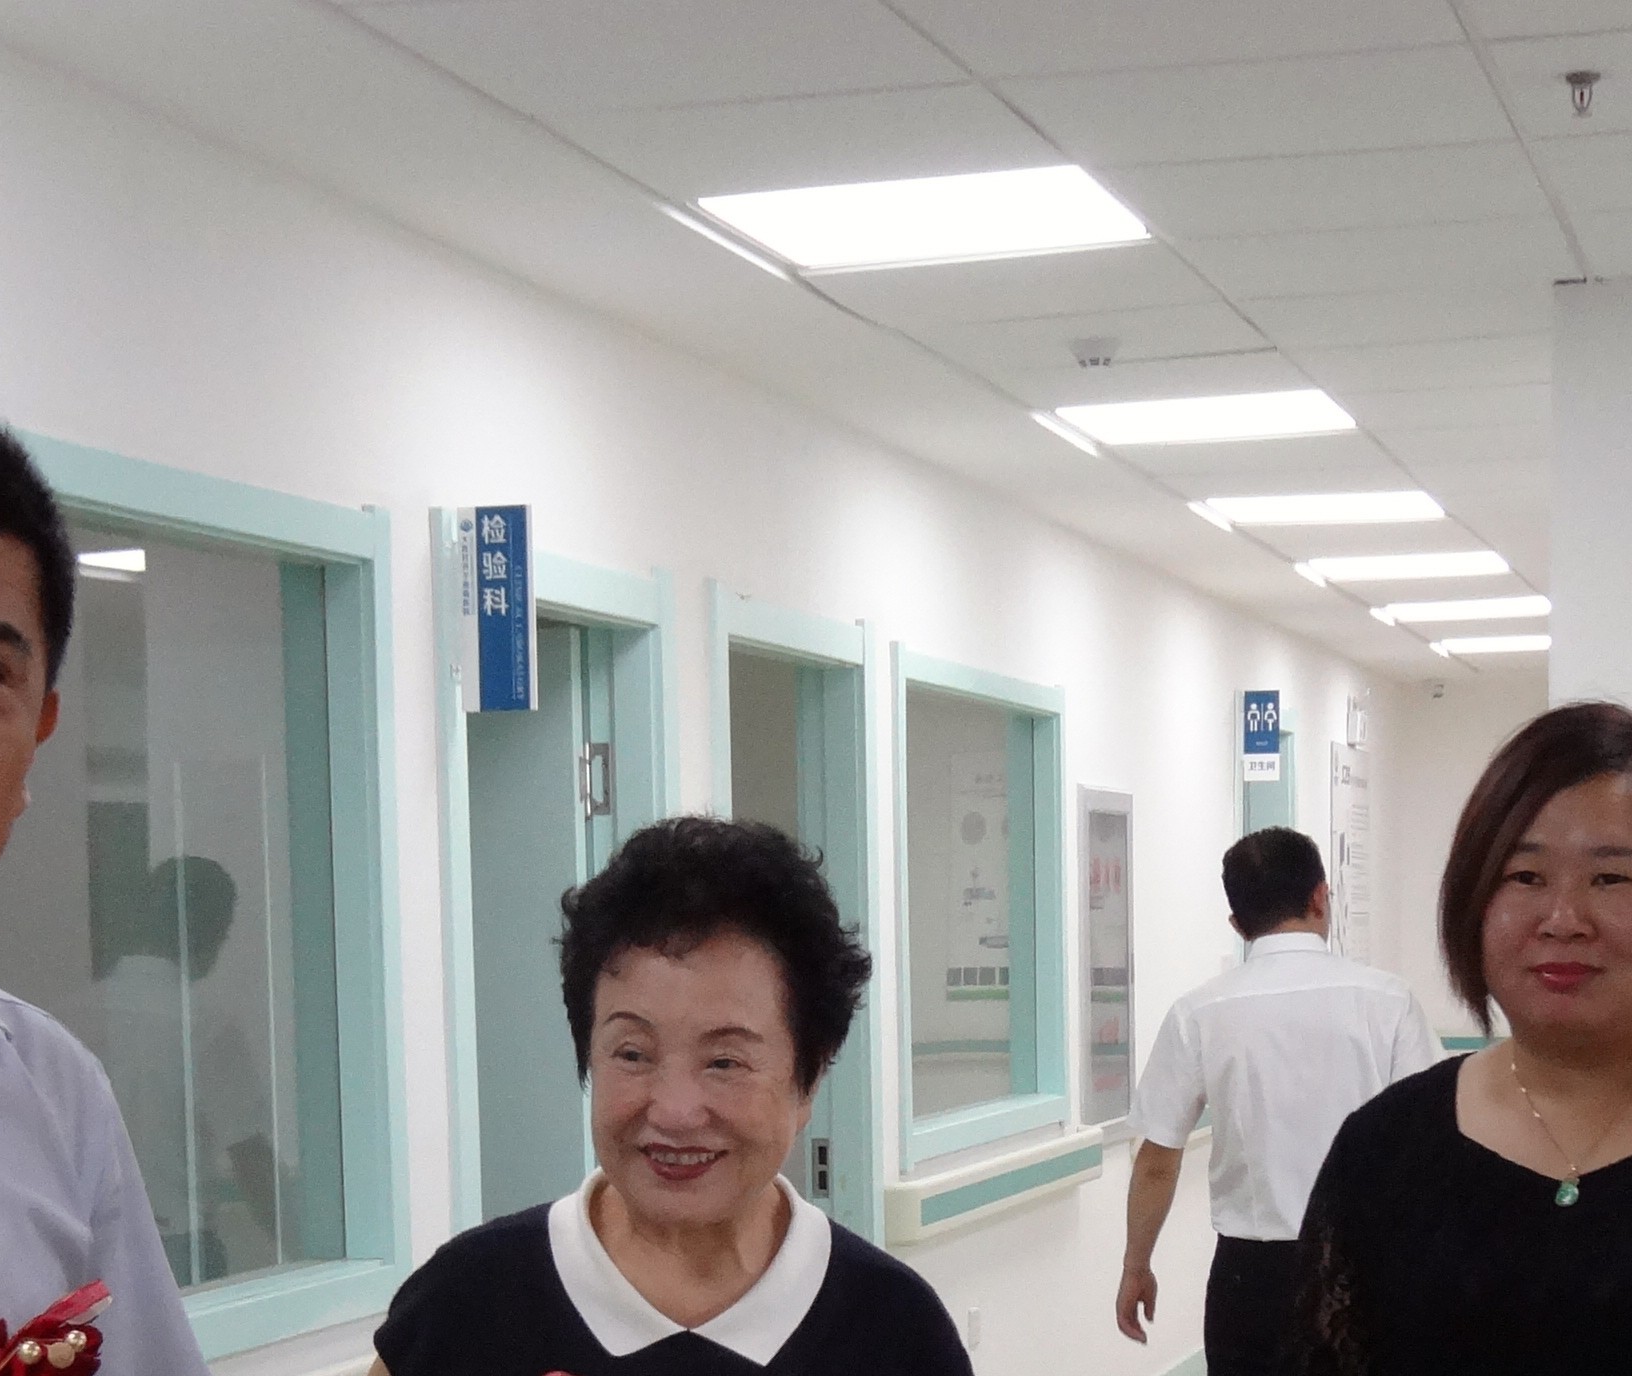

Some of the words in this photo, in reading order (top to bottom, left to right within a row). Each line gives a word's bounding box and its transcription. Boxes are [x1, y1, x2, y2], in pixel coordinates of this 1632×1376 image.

[481, 513, 509, 617] 检验科
[1248, 760, 1276, 772] 卫生间
